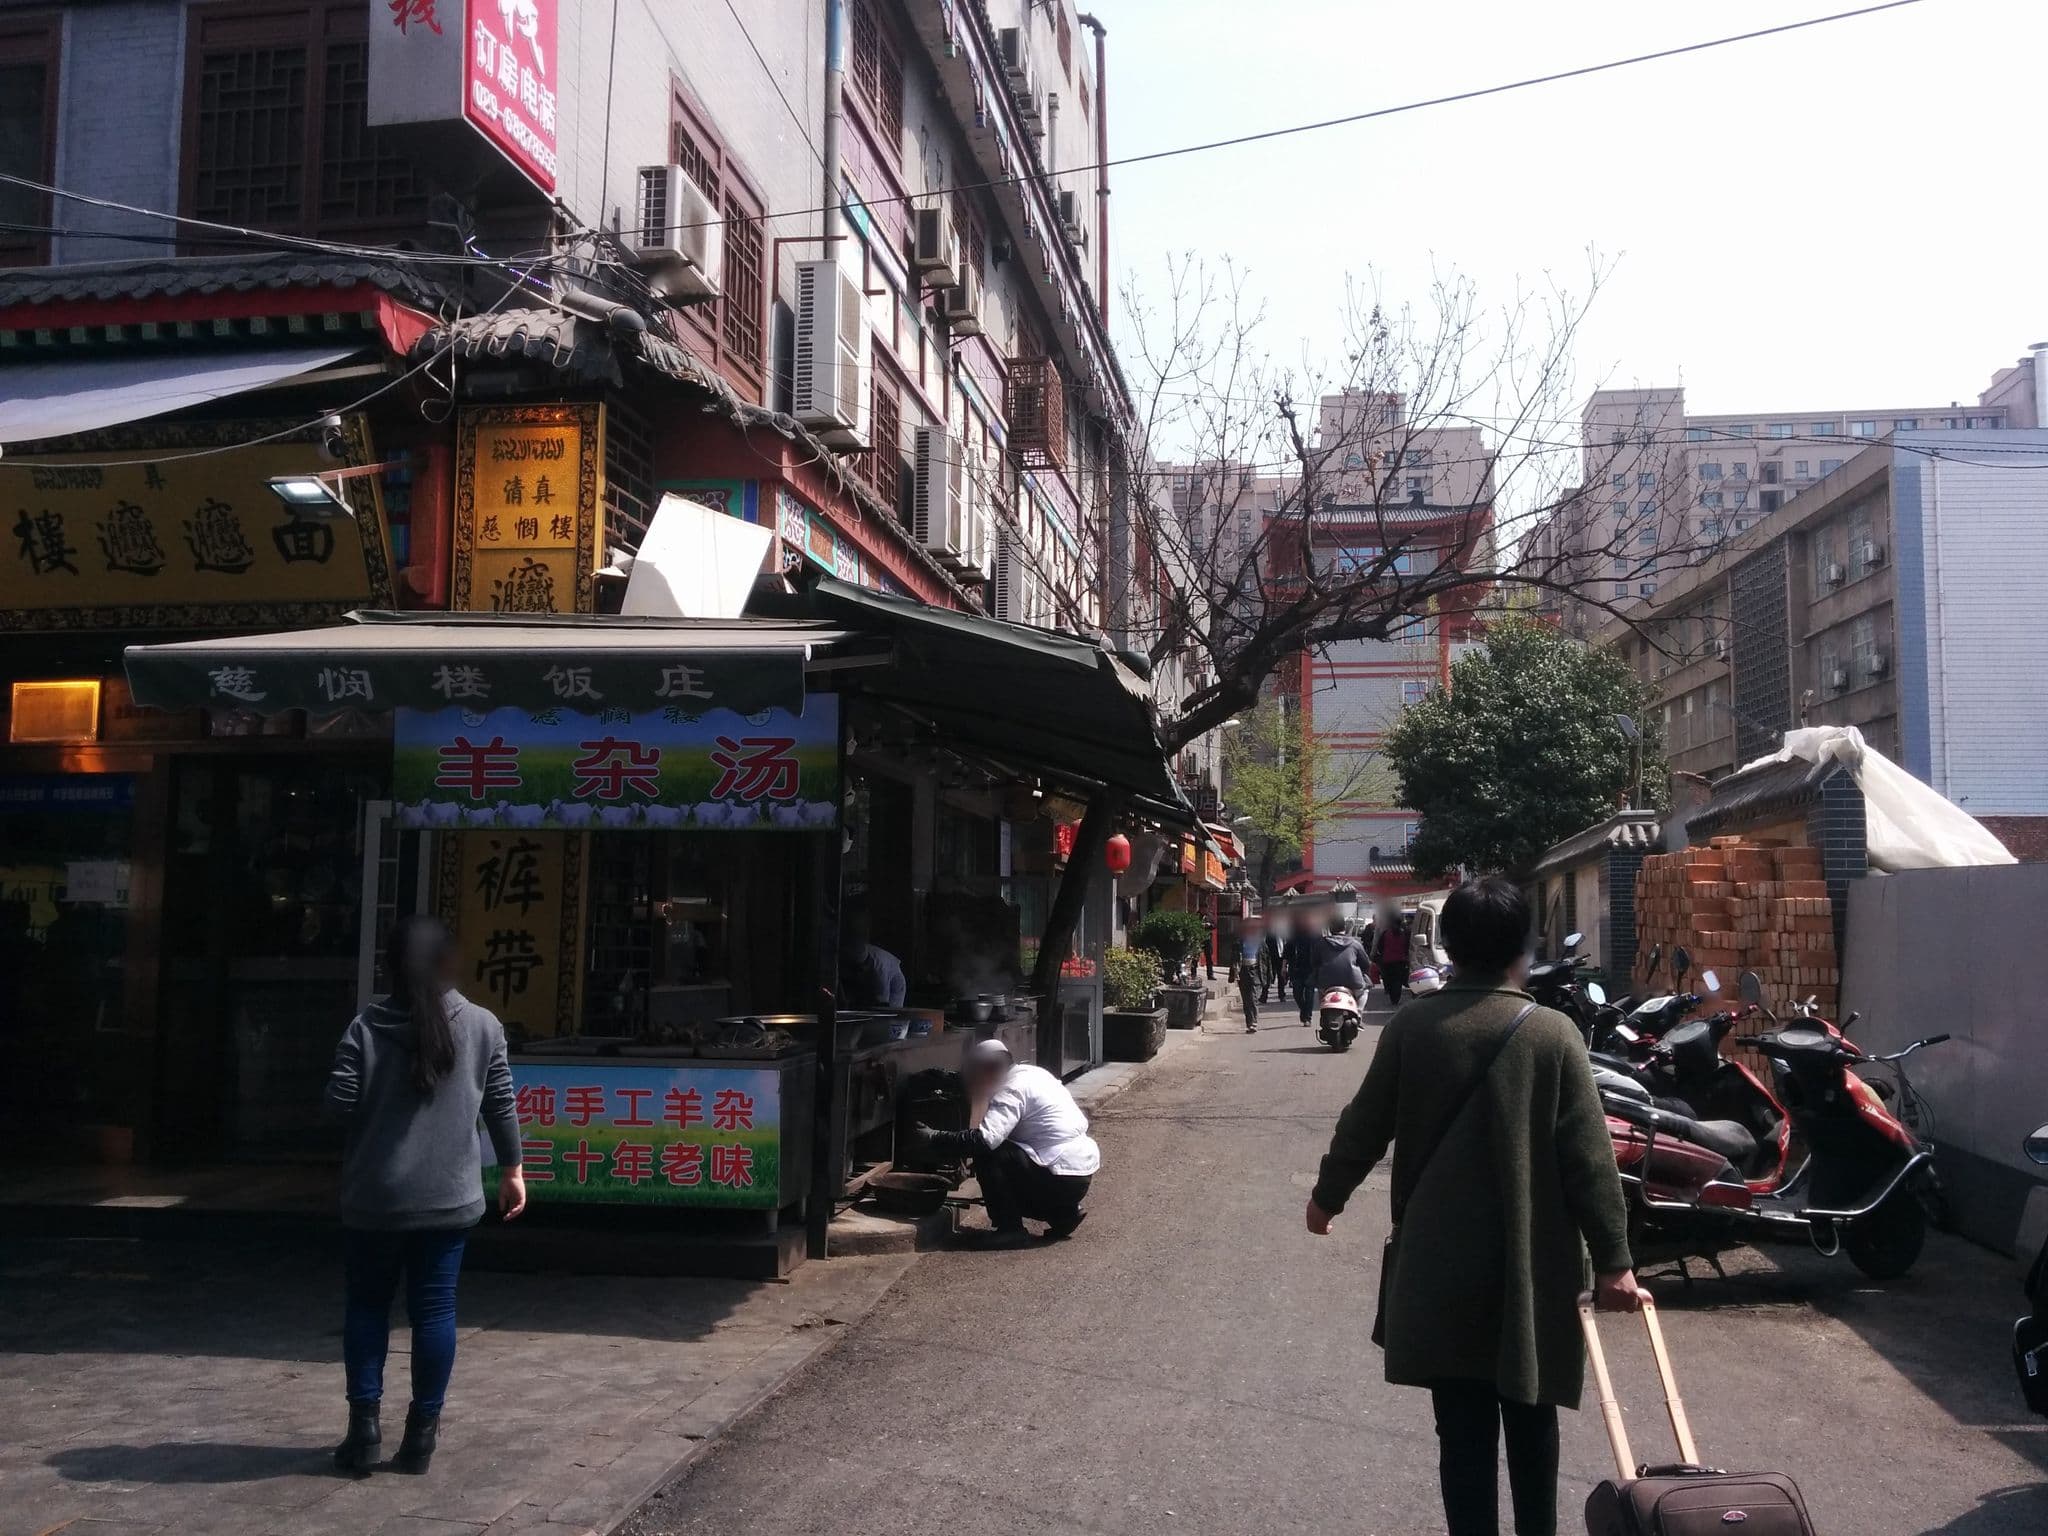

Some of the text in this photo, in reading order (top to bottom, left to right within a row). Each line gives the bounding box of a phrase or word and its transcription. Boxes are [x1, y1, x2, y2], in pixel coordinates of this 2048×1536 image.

[503, 475, 556, 505] 清真
[207, 664, 715, 701] 慈悯楼饭庄
[434, 735, 800, 801] 羊杂汤
[514, 1084, 755, 1132] 纯手工羊杂
[519, 1138, 754, 1188] 三十年老味
